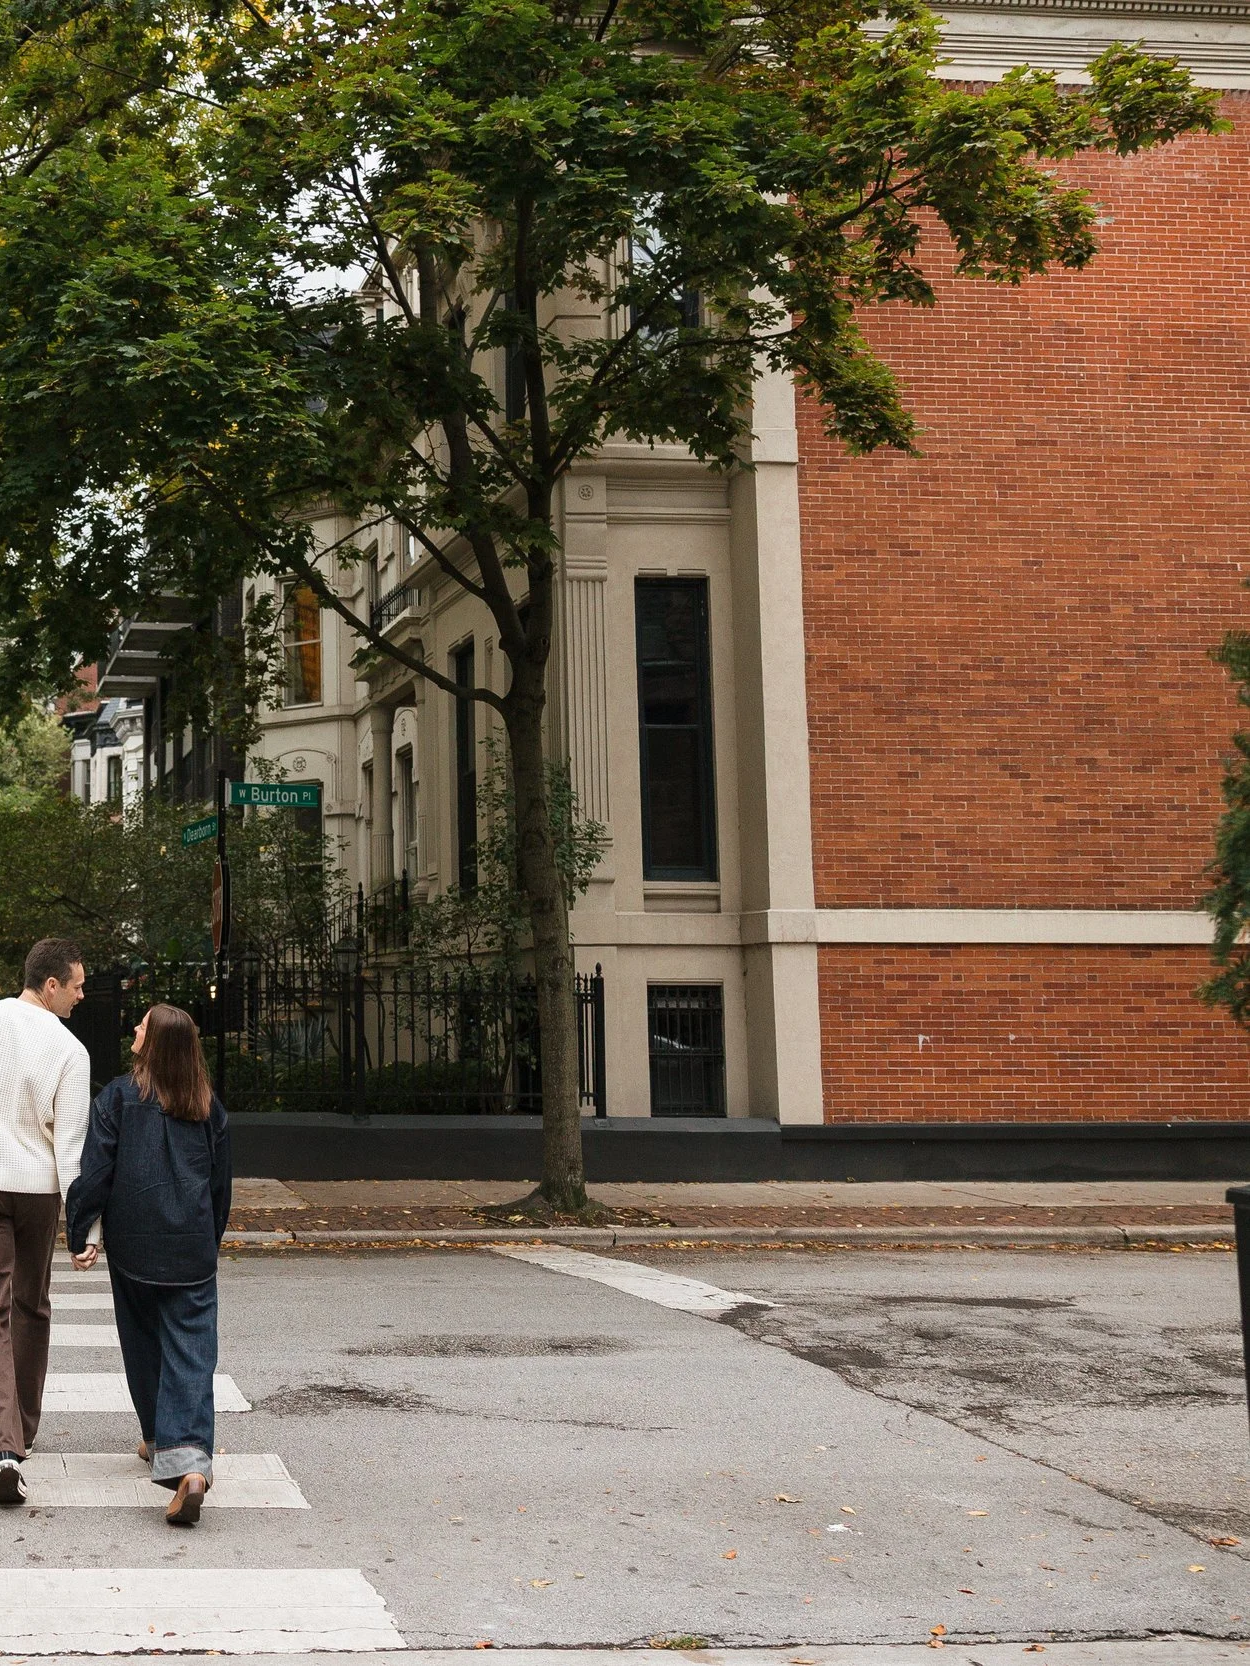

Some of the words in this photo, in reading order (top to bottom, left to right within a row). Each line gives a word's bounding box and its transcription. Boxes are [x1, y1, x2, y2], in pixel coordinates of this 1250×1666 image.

[239, 789, 246, 798] W
[251, 787, 298, 803] Burton
[302, 791, 311, 800] Pl
[187, 824, 211, 843] Dearborn
